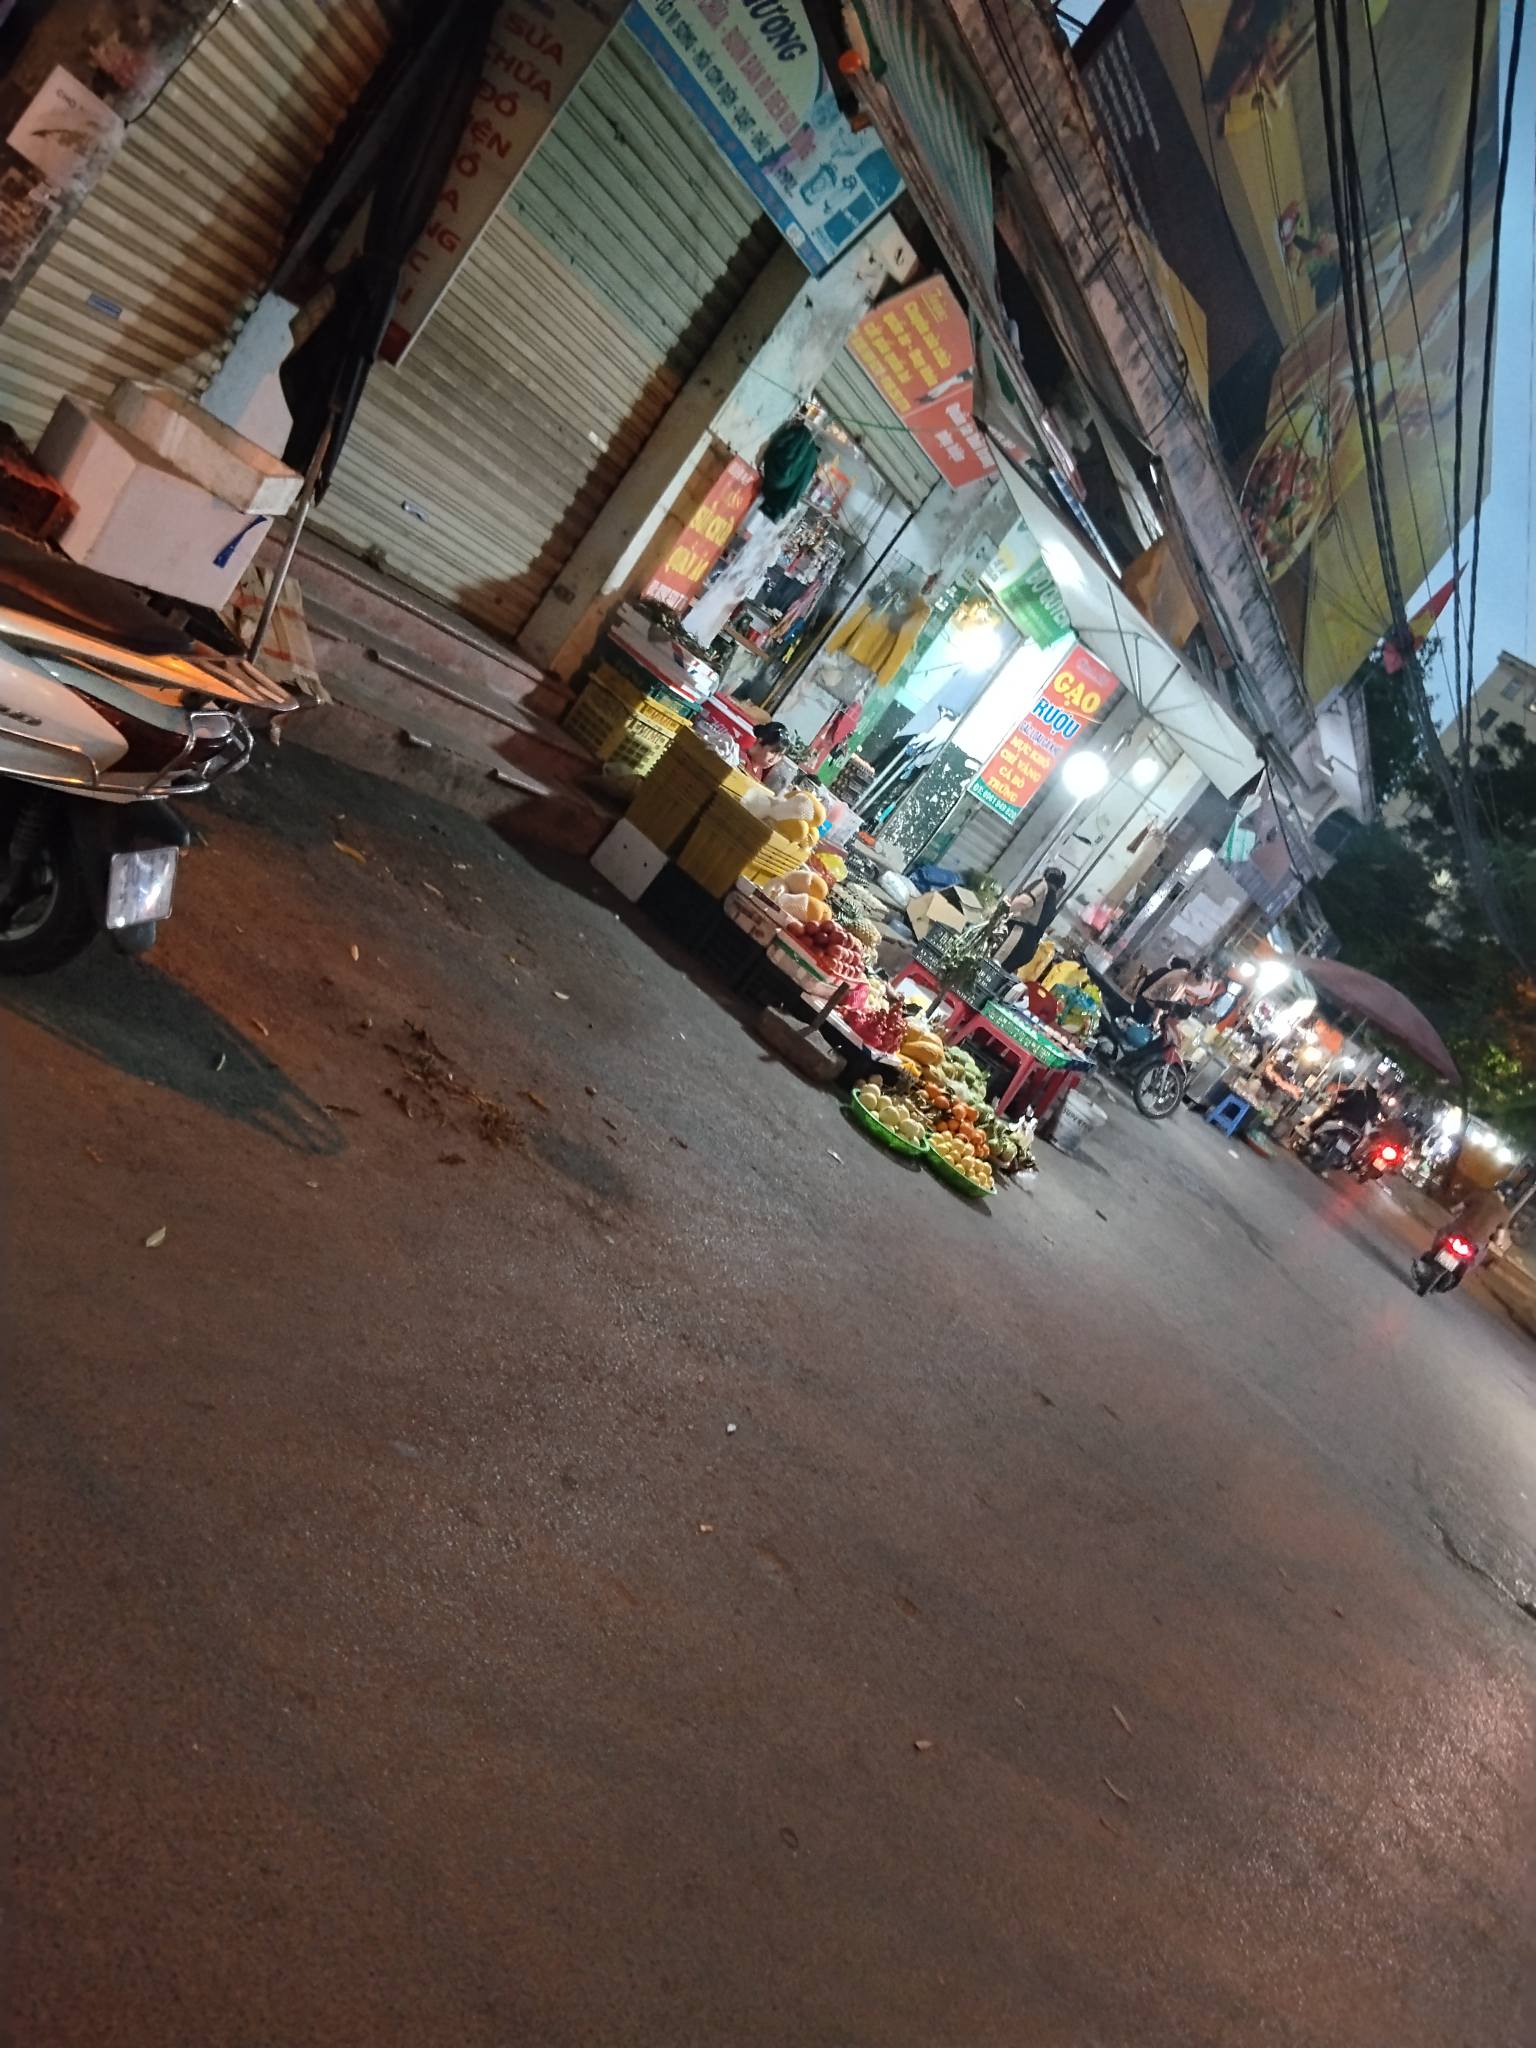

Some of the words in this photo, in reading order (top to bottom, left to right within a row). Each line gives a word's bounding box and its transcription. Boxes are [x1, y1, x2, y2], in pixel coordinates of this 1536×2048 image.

[1051, 668, 1103, 716] GẠO
[1031, 696, 1081, 740] RƯỢU
[1016, 760, 1041, 782] VÀNG
